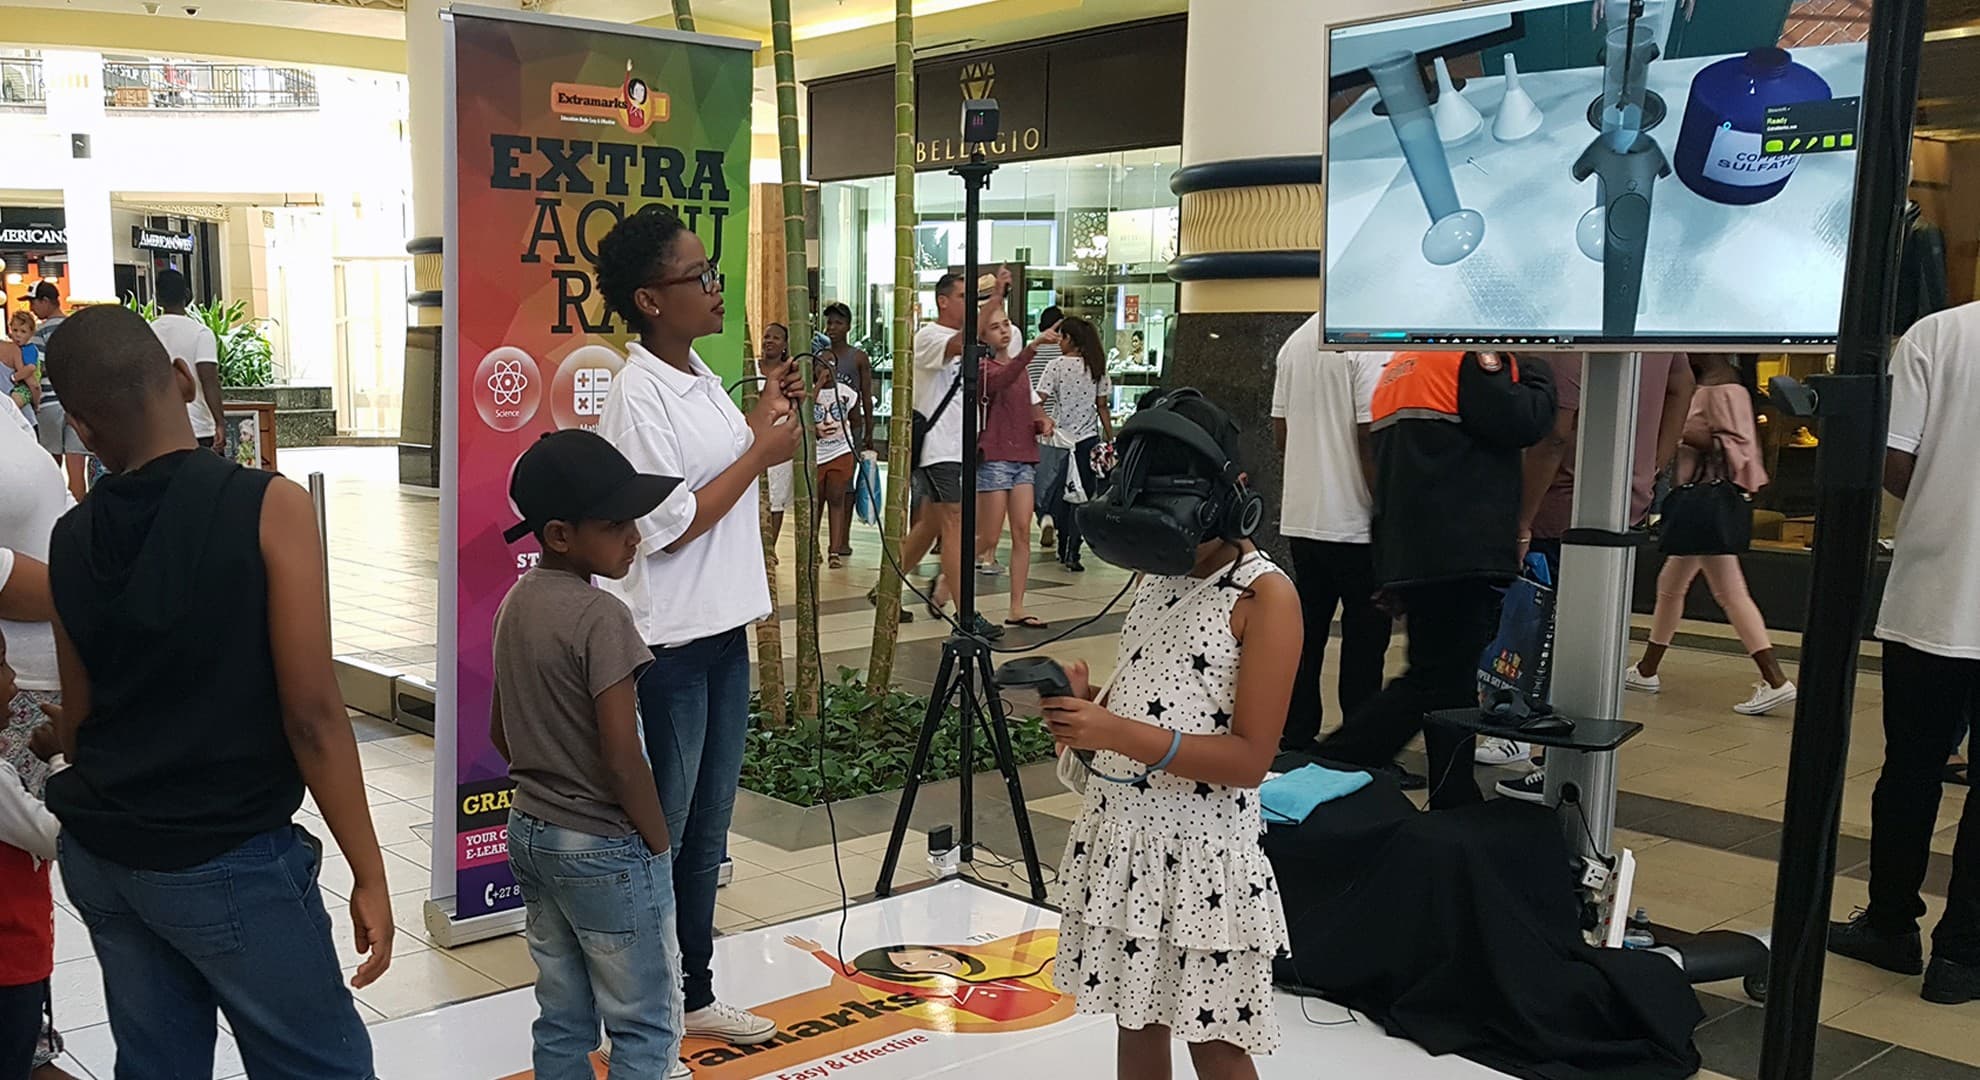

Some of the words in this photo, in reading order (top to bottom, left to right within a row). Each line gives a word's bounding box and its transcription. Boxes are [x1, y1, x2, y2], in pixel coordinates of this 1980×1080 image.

[558, 92, 628, 109] Extramarks
[916, 127, 1040, 163] BELLAGIO
[490, 133, 729, 202] EXTRA
[1717, 155, 1796, 172] SULFATE
[521, 197, 729, 267] ACU
[495, 409, 521, 418] Science
[465, 831, 497, 846] YOUR
[492, 886, 511, 899] +27
[825, 1059, 847, 1071] &
[845, 1033, 929, 1065] Effective
